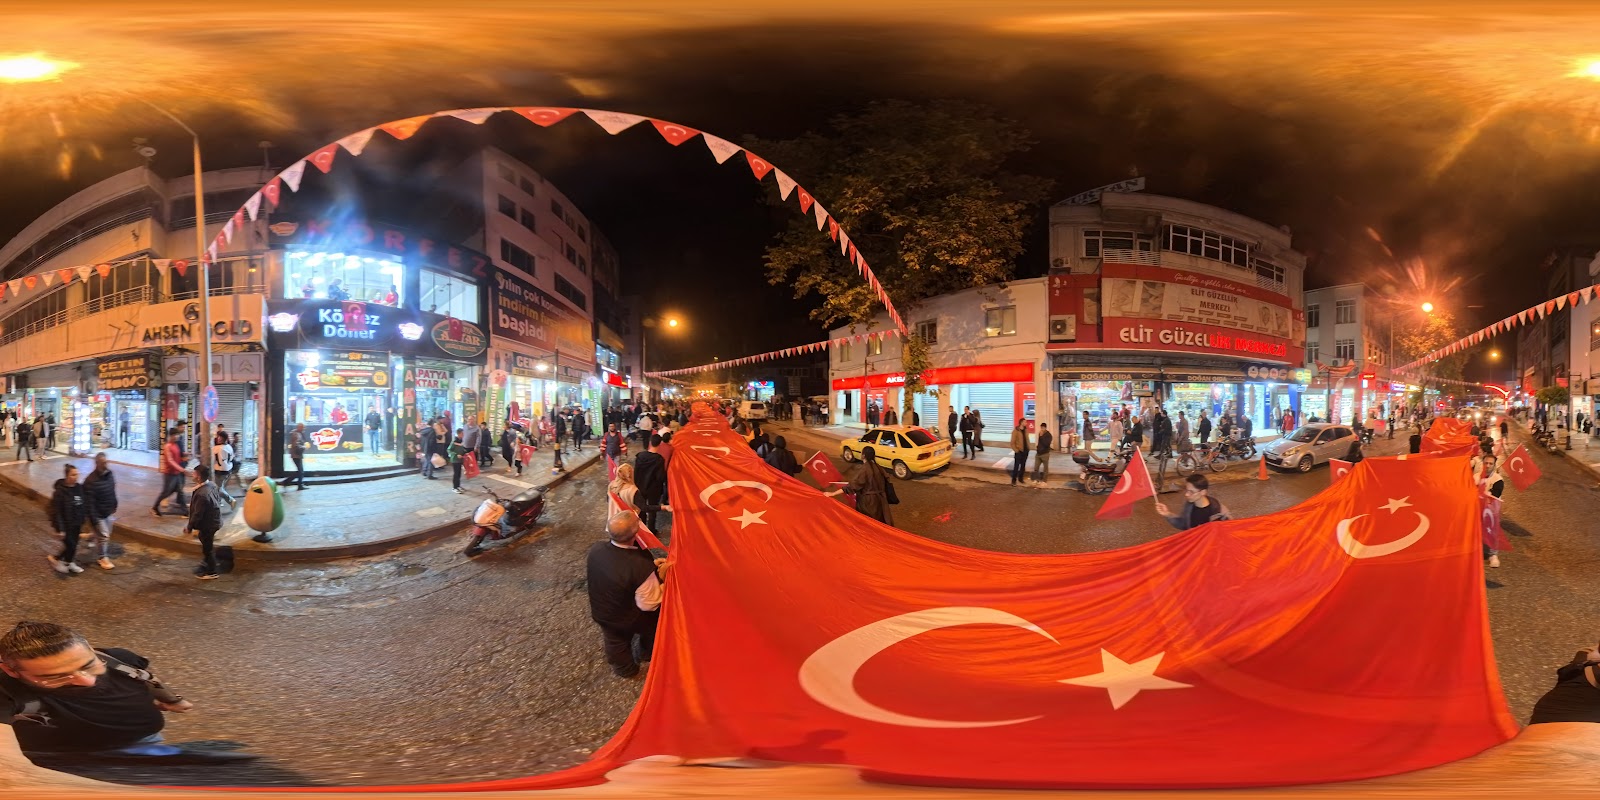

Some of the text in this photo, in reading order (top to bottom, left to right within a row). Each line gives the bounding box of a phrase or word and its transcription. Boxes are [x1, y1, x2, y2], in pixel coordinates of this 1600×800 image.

[523, 290, 540, 305] çok
[1191, 287, 1239, 303] ELİT GÜZELLİK
[499, 292, 539, 320] indirim
[1199, 301, 1231, 313] MERKEZİ
[142, 323, 192, 342] AHSEN
[209, 320, 252, 336] OLD
[323, 324, 377, 340] Döner
[498, 308, 547, 342] başladı
[1119, 324, 1287, 358] ELİT GÜZELLİK MERKEZİ
[416, 368, 447, 380] PATYA
[1081, 372, 1111, 380] DOĞAN
